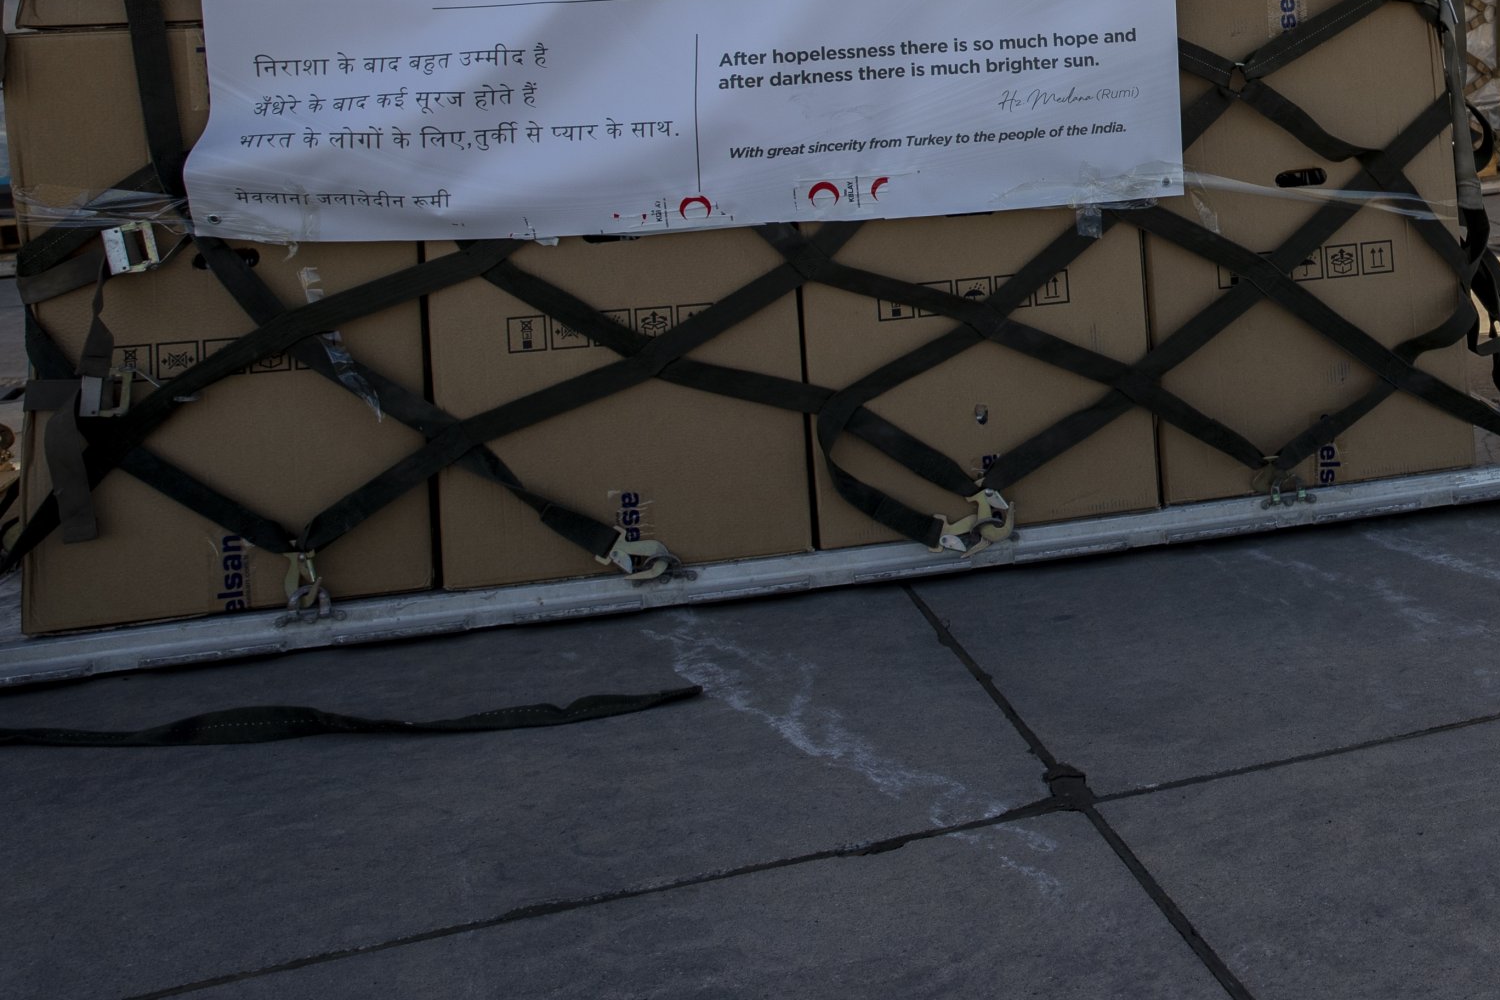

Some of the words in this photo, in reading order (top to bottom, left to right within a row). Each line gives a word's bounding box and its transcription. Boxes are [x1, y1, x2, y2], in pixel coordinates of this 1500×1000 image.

[253, 54, 329, 77] निराशा
[338, 52, 356, 74] के
[363, 56, 402, 73] बाद
[409, 53, 452, 76] बहुत
[460, 43, 525, 67] उम्मीद
[534, 42, 548, 68] है
[719, 50, 767, 68] After
[772, 44, 895, 66] hopelessness
[900, 40, 948, 56] there
[953, 37, 967, 52] is
[973, 38, 993, 51] so
[1000, 33, 1048, 50] much
[1053, 31, 1098, 49] hope
[1103, 28, 1137, 43] and
[718, 71, 764, 90] after
[770, 69, 853, 87] darkness
[858, 64, 906, 81] there
[911, 62, 925, 77] is
[931, 58, 980, 76] much
[986, 55, 1058, 74] brighter
[1064, 54, 1099, 69] sun.
[309, 93, 326, 112] के
[333, 95, 370, 112] बाद
[377, 86, 408, 111] कई
[416, 91, 465, 115] सूरज
[474, 83, 514, 111] होते
[522, 81, 537, 108] हैं
[1096, 86, 1139, 102] (Rumi)
[240, 132, 295, 149] भारत
[303, 127, 321, 149] के
[329, 126, 383, 149] लोगों
[392, 126, 411, 149] के
[526, 120, 543, 143] से
[551, 124, 598, 141] प्यार
[606, 117, 623, 139] के
[729, 146, 763, 159] With
[767, 142, 804, 159] great
[808, 138, 866, 155] sincerity
[869, 136, 902, 150] from
[907, 133, 952, 148] Turkey
[955, 132, 970, 144] to
[973, 130, 996, 143] the
[998, 127, 1046, 143] people
[1049, 125, 1064, 138] of
[1066, 123, 1088, 136] the
[1091, 121, 1126, 135] India.
[217, 535, 246, 612] elsan
